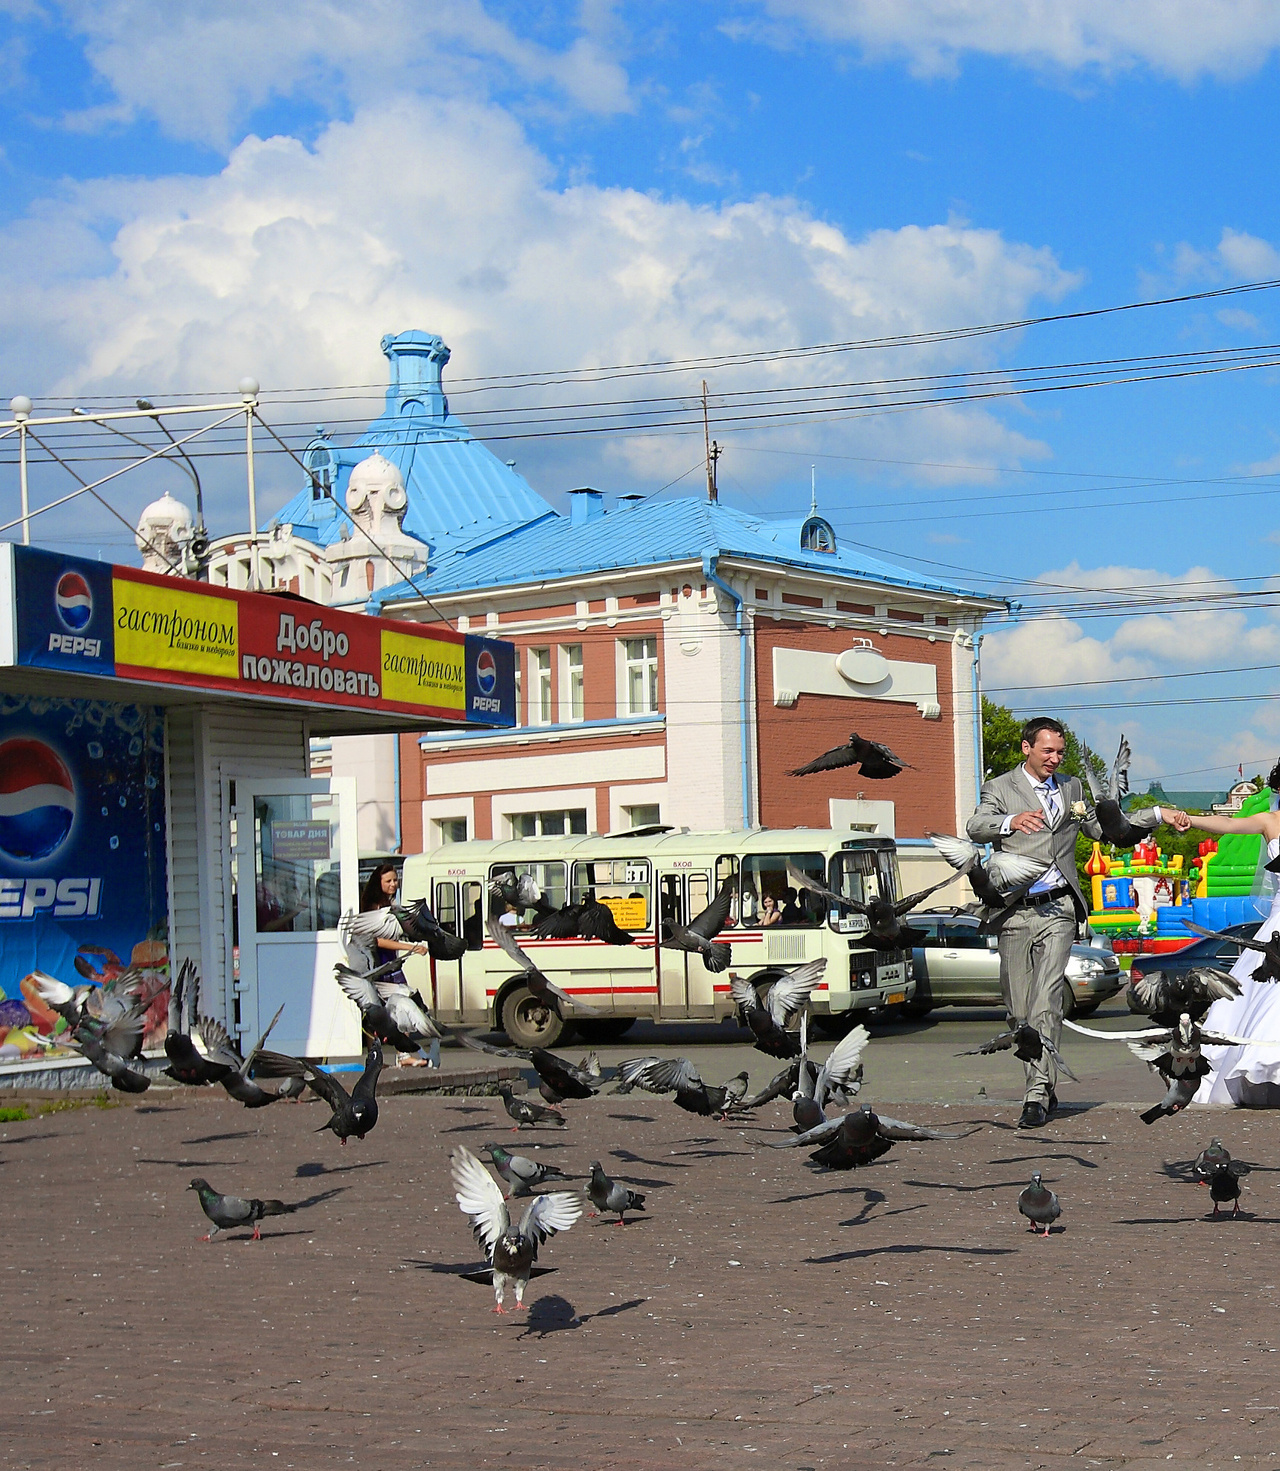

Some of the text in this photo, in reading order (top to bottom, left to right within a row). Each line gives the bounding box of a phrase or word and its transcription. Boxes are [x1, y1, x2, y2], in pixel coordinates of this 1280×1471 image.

[118, 607, 235, 648] гастроном
[277, 613, 349, 661] Добро
[48, 632, 102, 658] PEPSI
[242, 654, 380, 697] пожаловать
[383, 652, 464, 686] гастроном
[472, 696, 500, 713] PEPSI
[275, 829, 328, 839] ТОВАР ДНЯ
